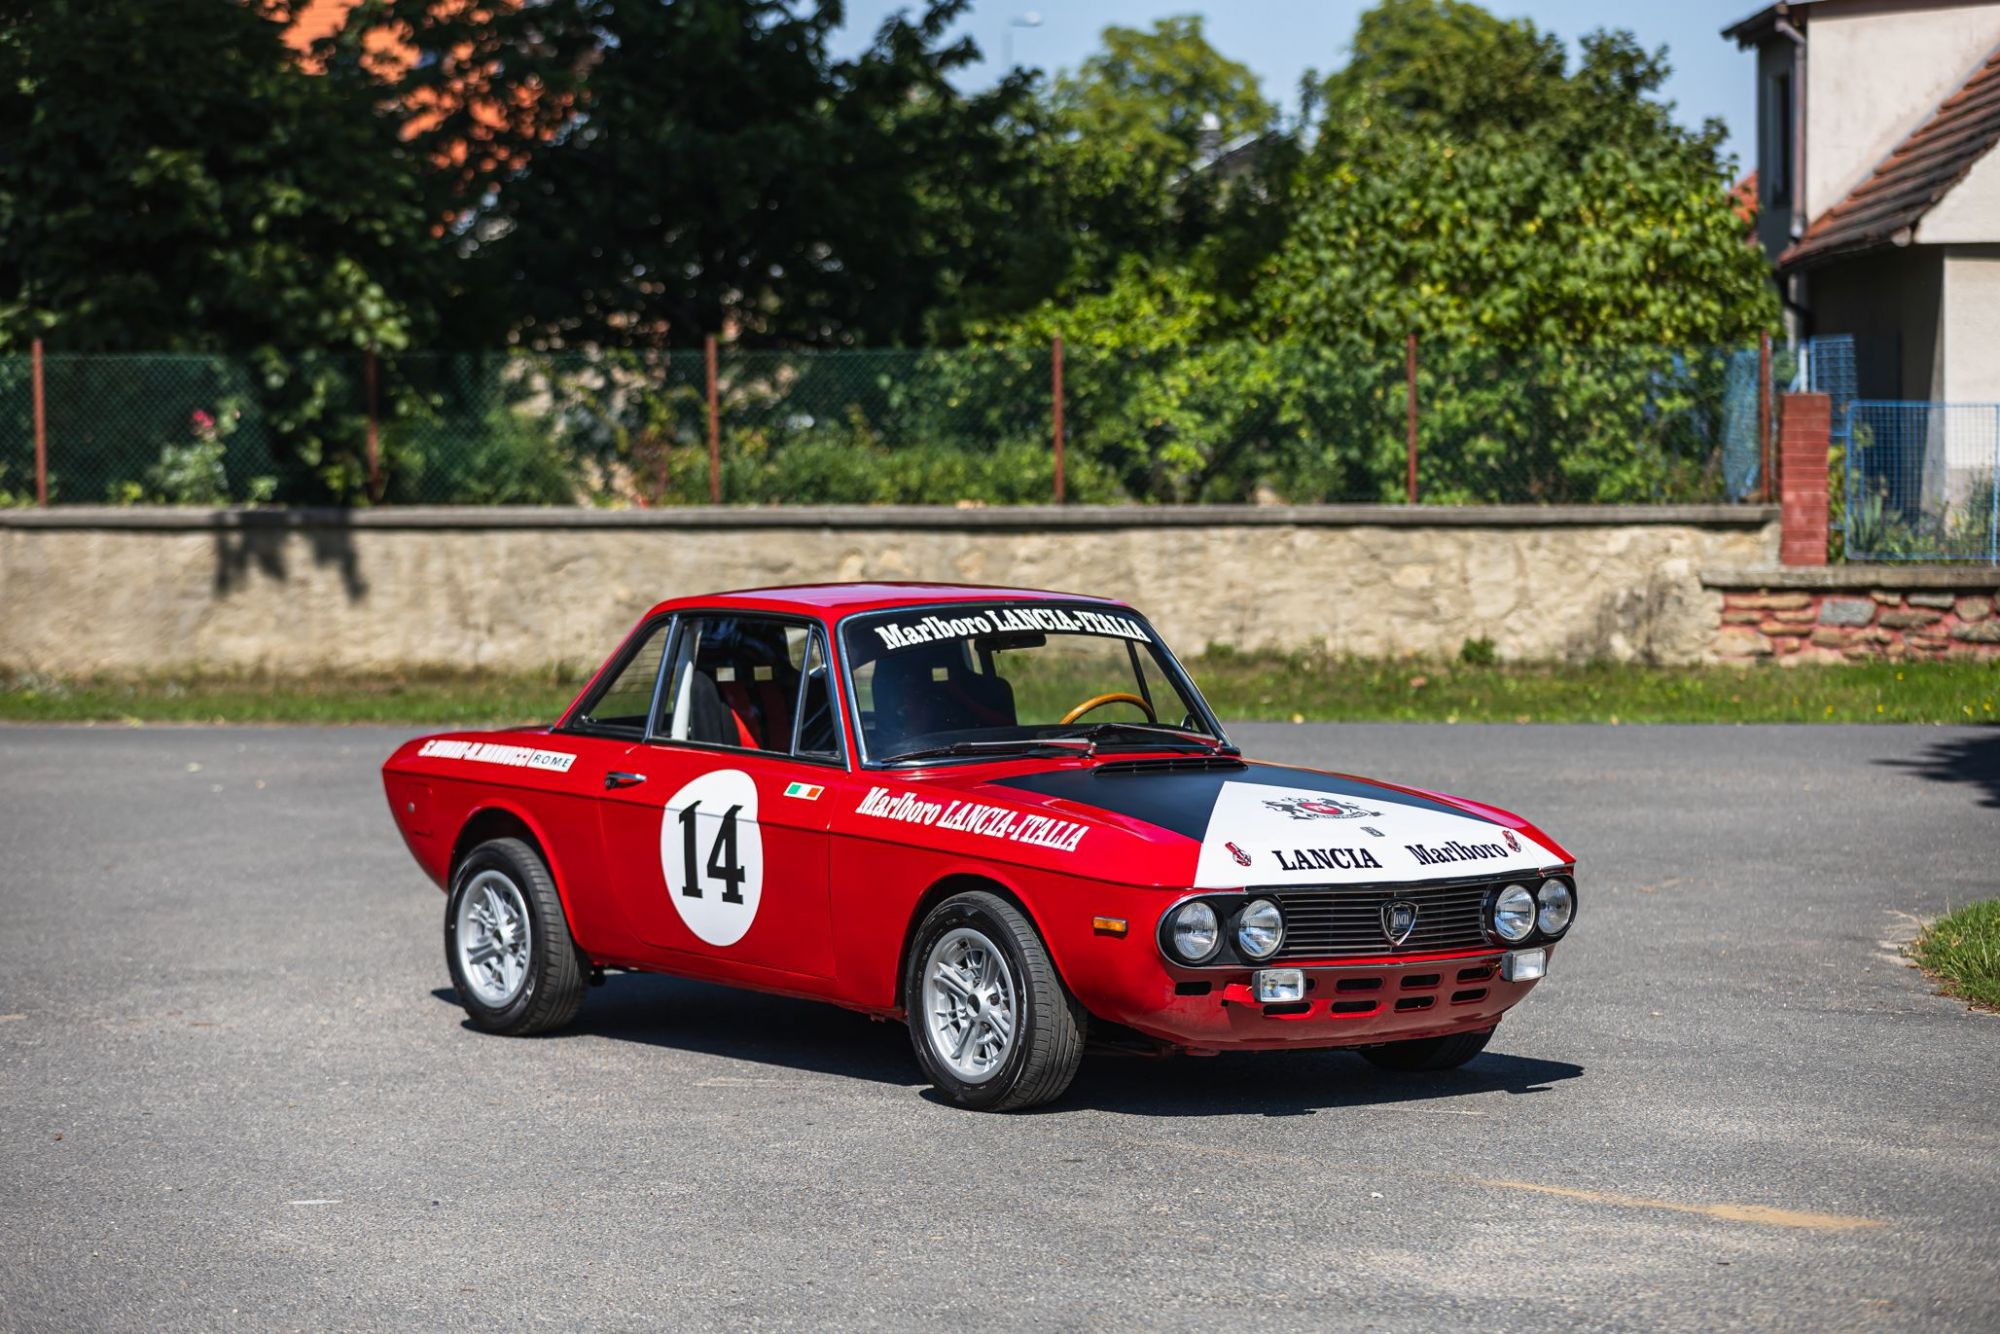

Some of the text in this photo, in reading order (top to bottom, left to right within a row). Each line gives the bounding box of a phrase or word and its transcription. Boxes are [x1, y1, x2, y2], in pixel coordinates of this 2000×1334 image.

[874, 608, 1153, 650] Marlboro LANCIA-ITALIA
[533, 754, 571, 768] ROME
[855, 786, 1090, 853] Marlboro LANCIA-ITALIA
[678, 800, 746, 905] 14
[1272, 848, 1383, 871] LANCIA
[1404, 841, 1509, 866] Marlboro
